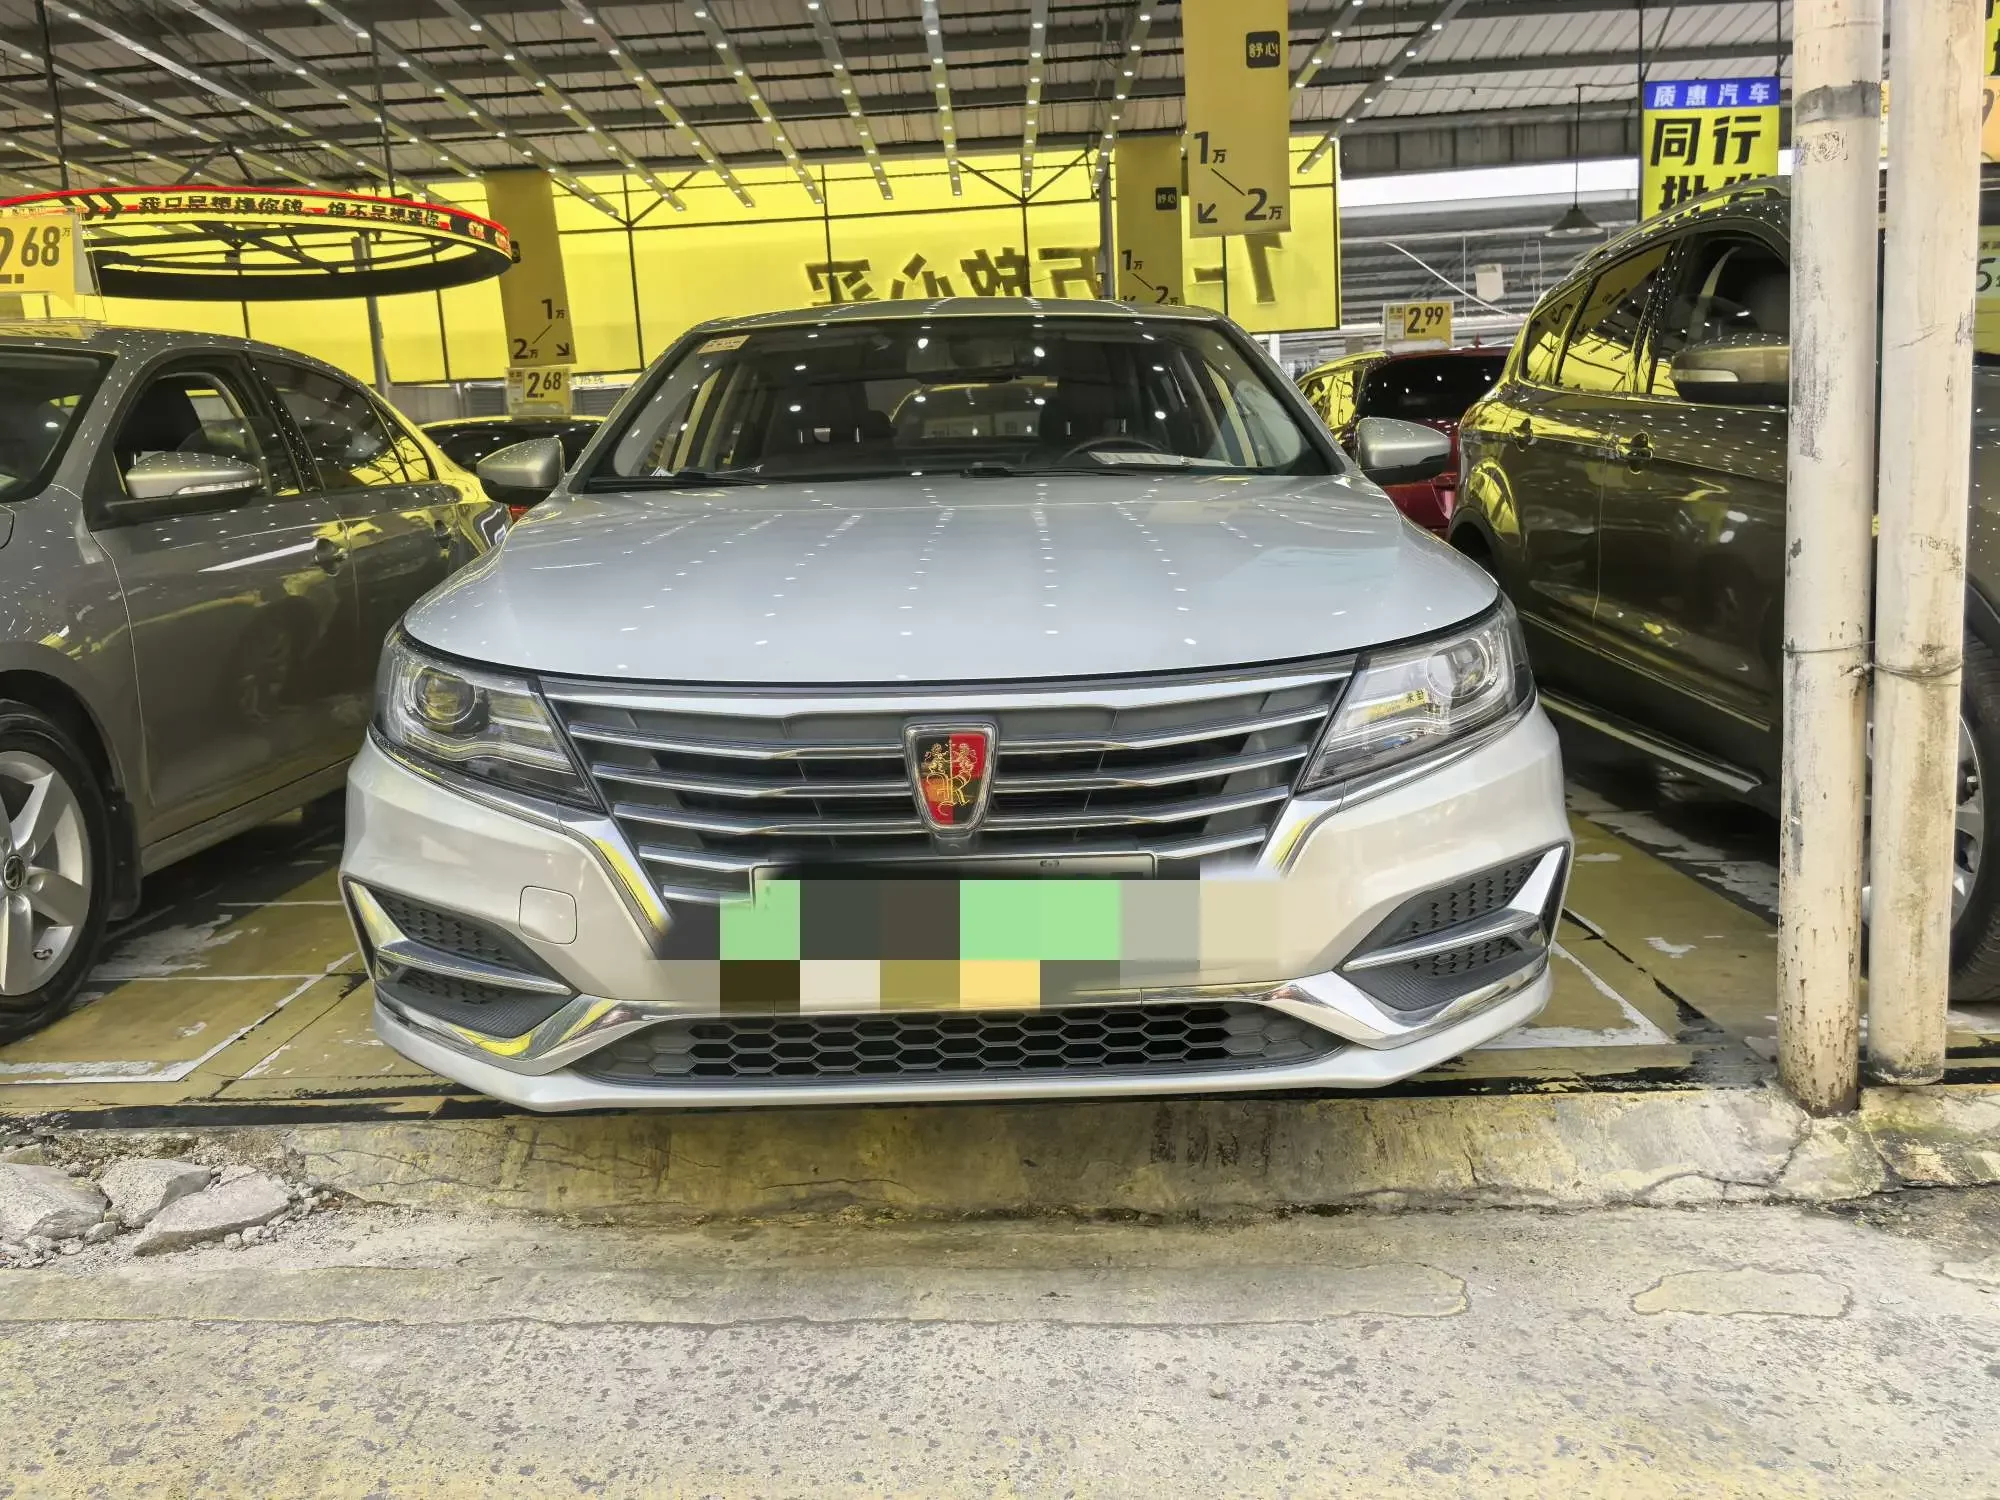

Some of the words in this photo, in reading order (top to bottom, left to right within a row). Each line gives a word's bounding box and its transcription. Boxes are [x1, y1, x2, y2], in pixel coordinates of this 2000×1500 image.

[1249, 42, 1279, 58] 舒心
[1653, 82, 1770, 107] 质惠汽车
[1194, 131, 1226, 164] 1万
[1650, 115, 1762, 167] 同行
[1245, 188, 1283, 221] 2万
[1658, 173, 1767, 211] 批
[541, 298, 566, 320] 1万
[1406, 306, 1444, 334] 2.99
[513, 338, 538, 360] 2万
[526, 372, 562, 399] 2.68
